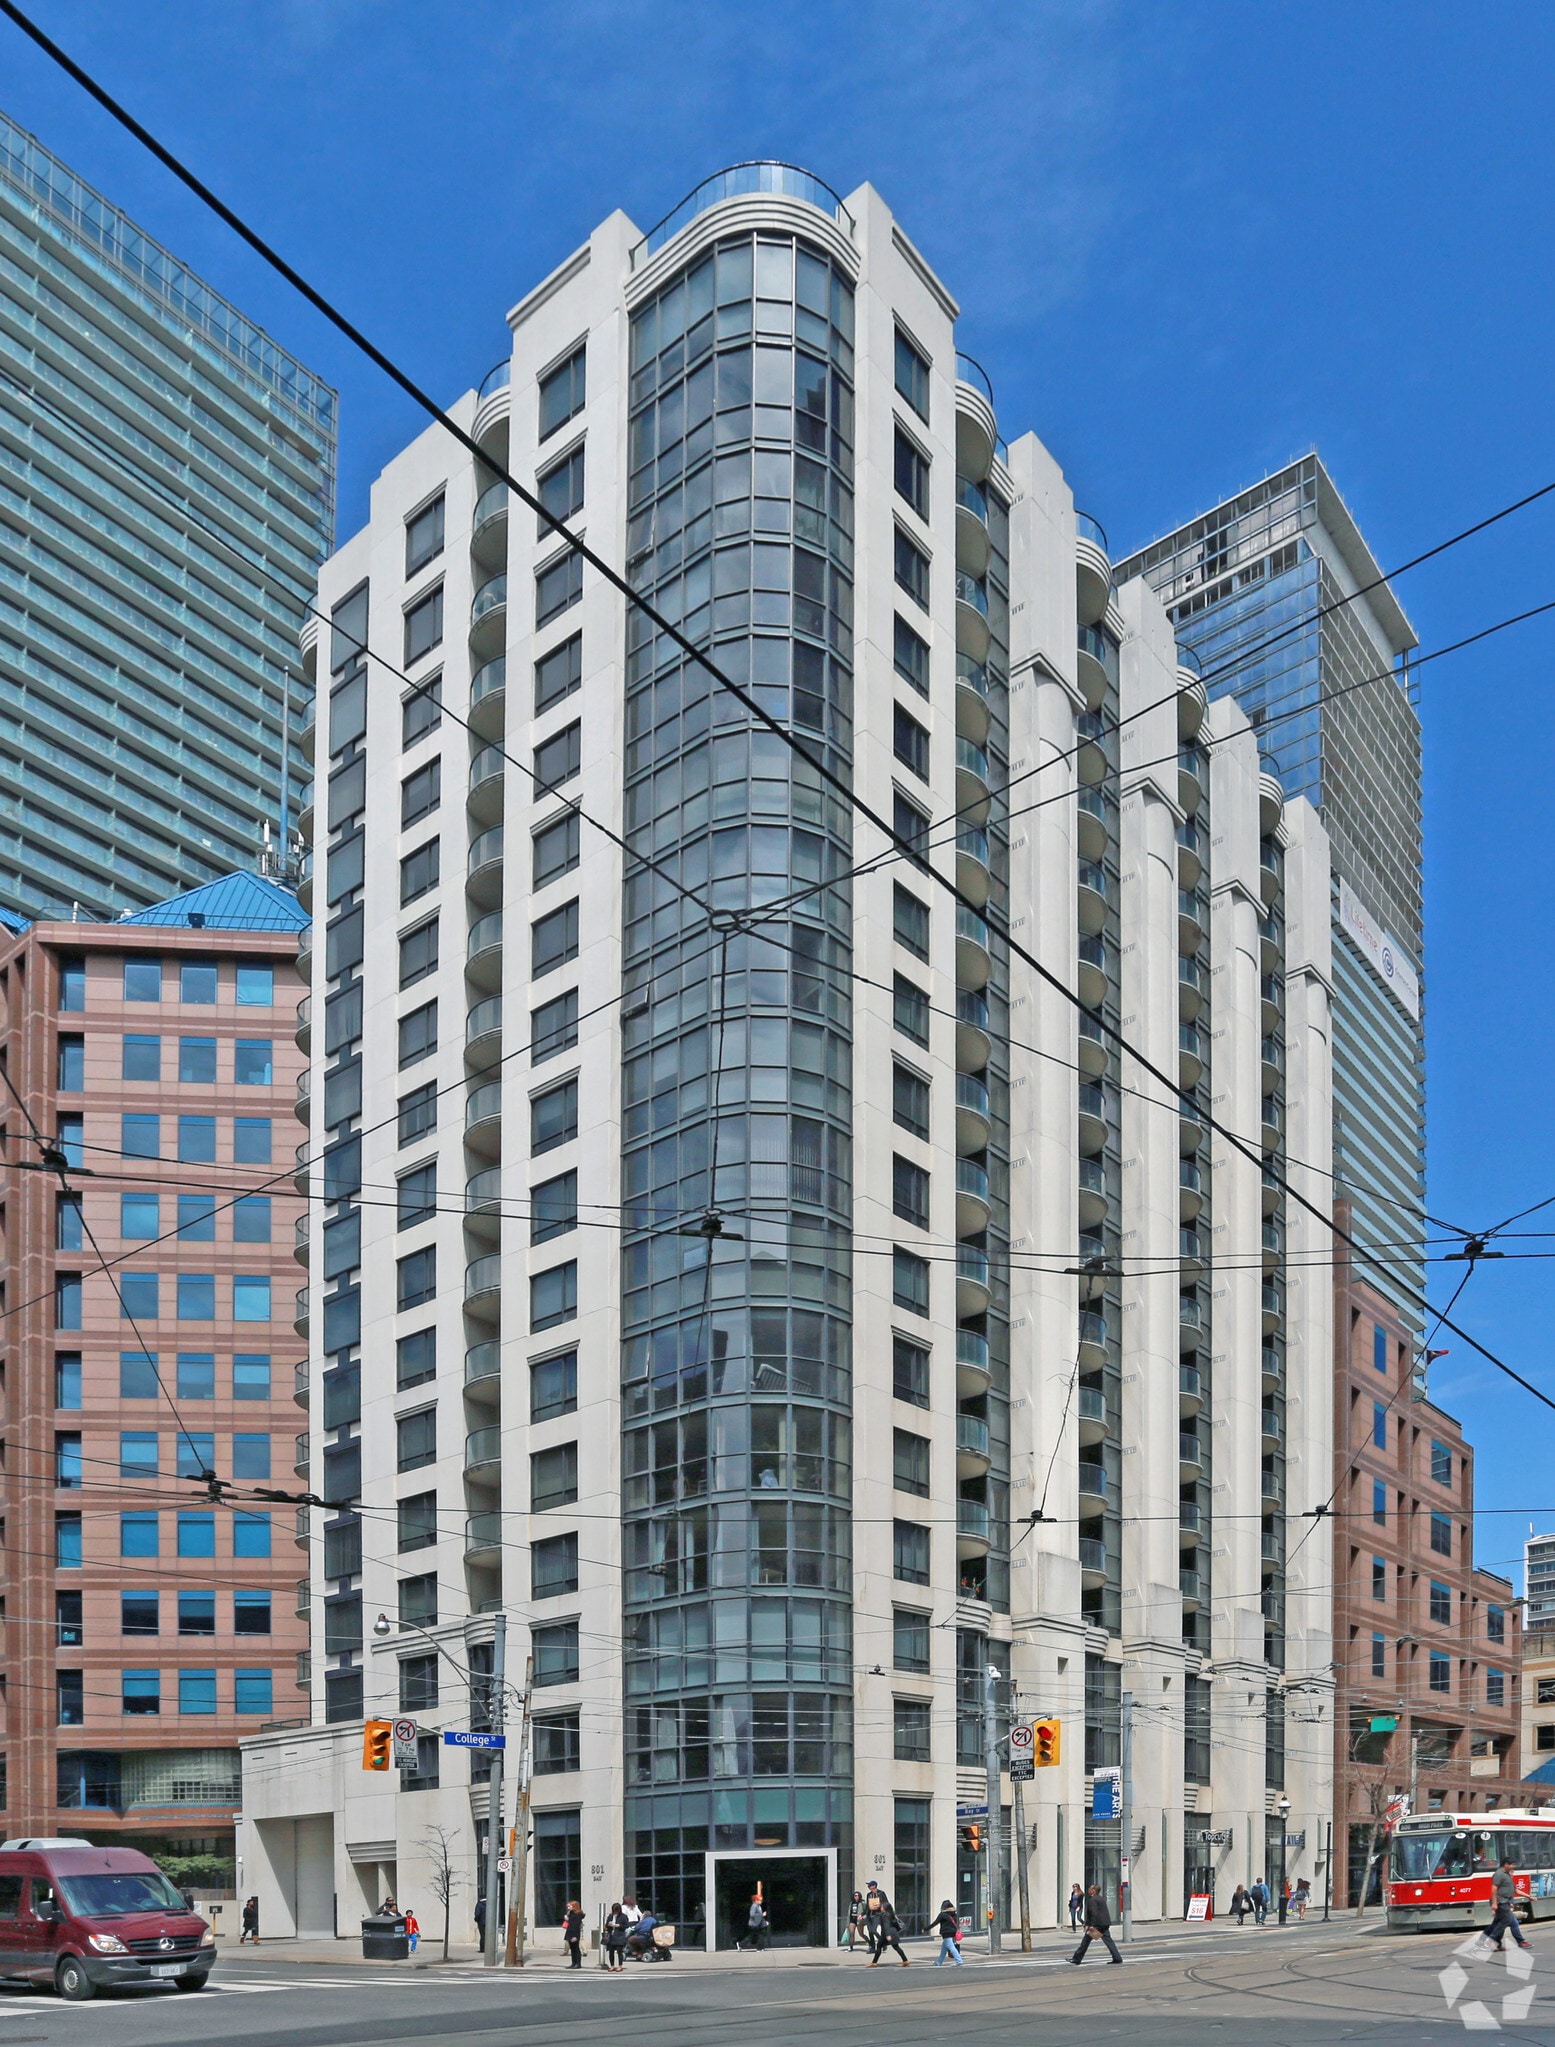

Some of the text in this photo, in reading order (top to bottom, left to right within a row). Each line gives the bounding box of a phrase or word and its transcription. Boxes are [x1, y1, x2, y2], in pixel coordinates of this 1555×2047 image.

[454, 1733, 489, 1746] College
[1112, 1776, 1121, 1819] THE ARTS
[873, 1854, 886, 1864] 801
[591, 1864, 605, 1874] 801
